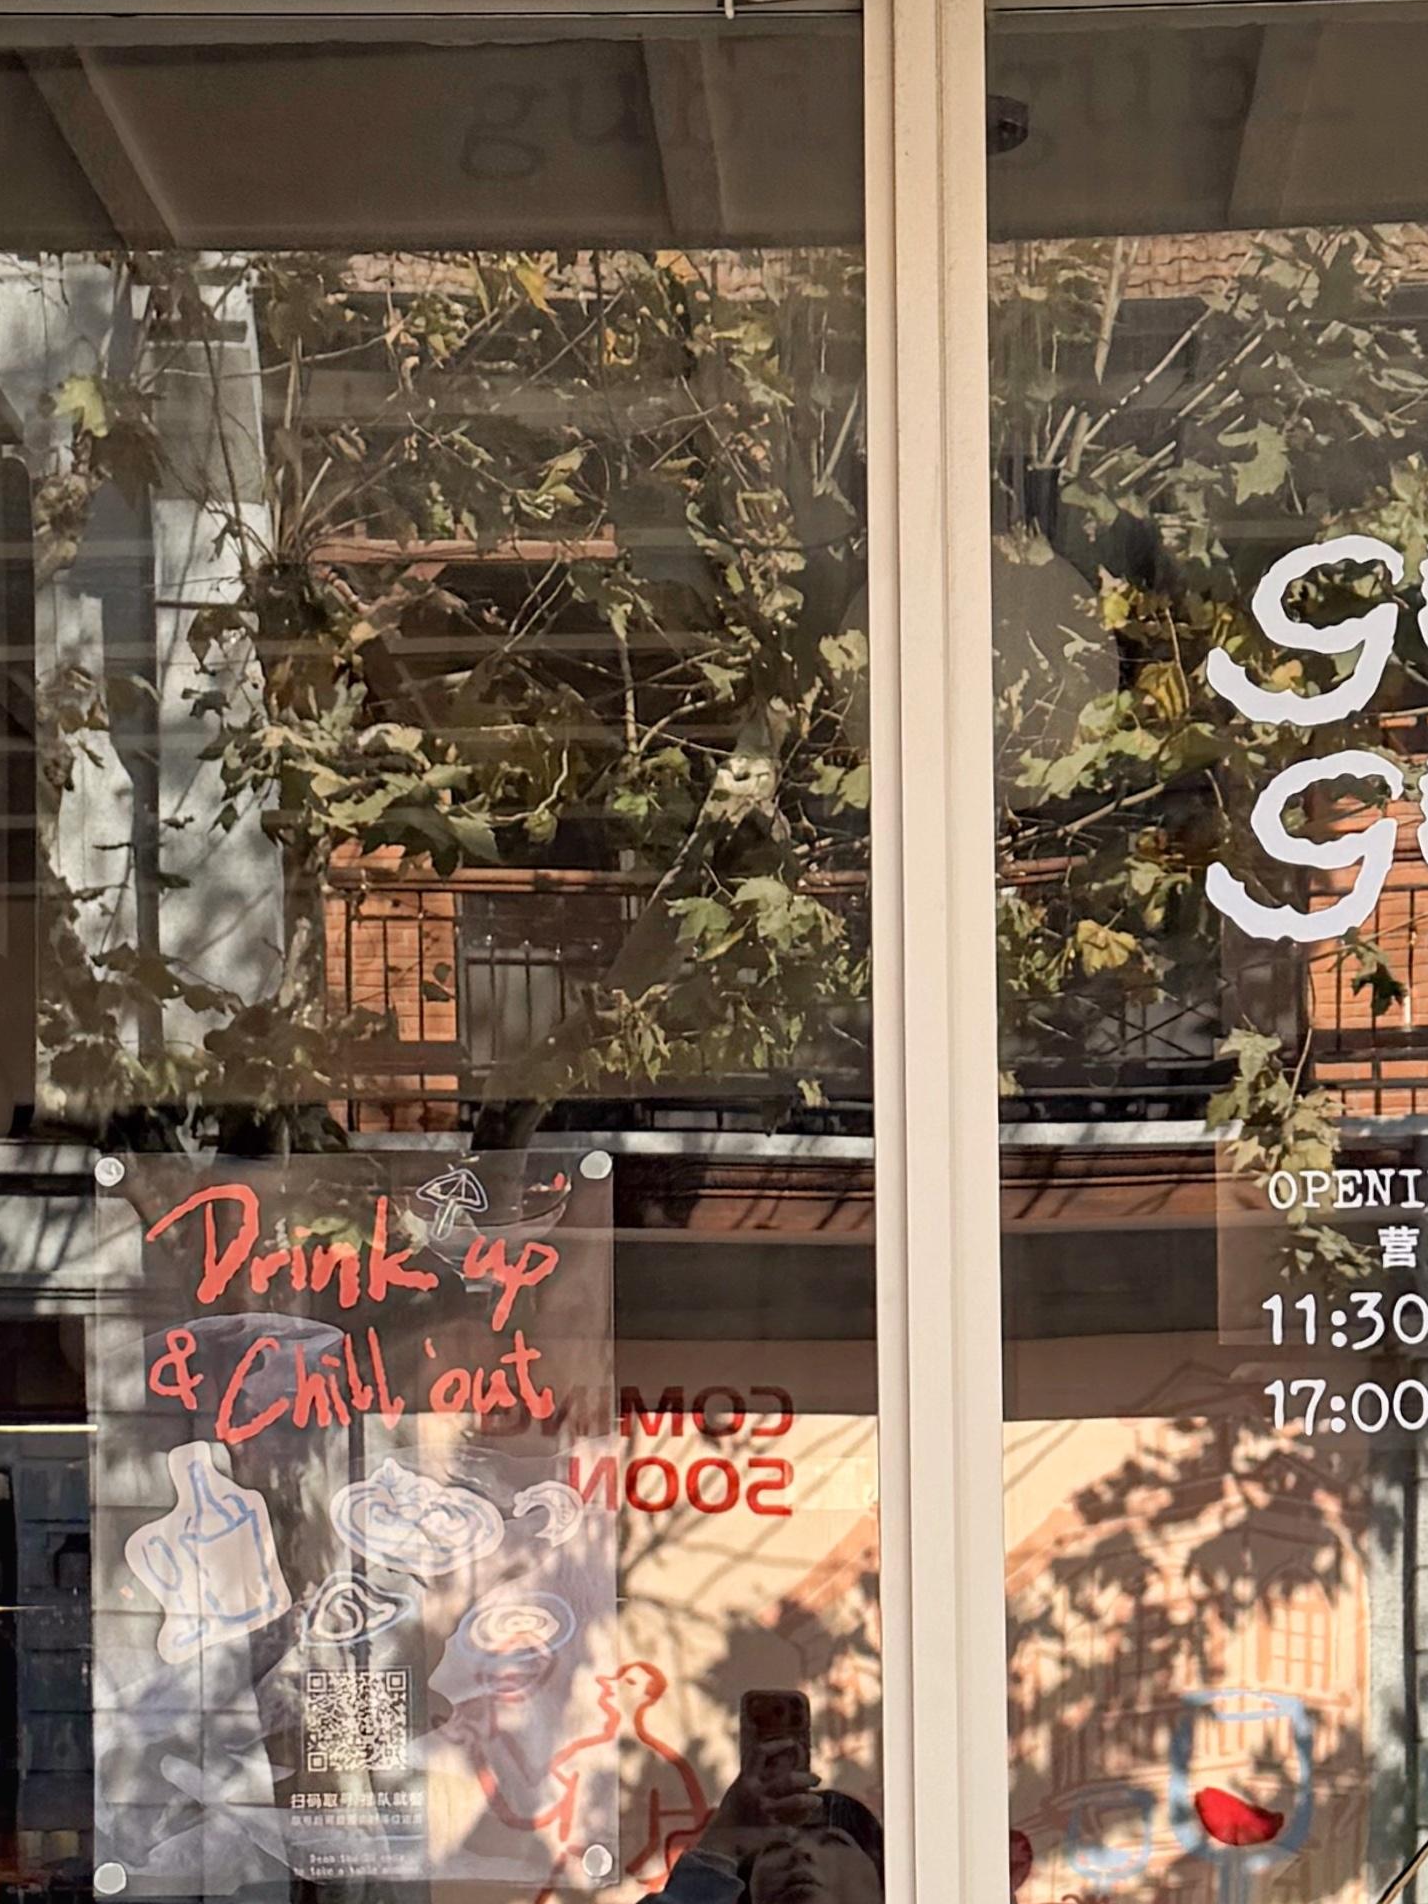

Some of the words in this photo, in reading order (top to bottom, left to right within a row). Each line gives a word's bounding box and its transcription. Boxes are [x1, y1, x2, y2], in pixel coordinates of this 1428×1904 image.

[146, 1184, 439, 1308] Drink
[463, 1235, 559, 1332] up
[149, 1328, 204, 1409] &
[215, 1327, 405, 1445] Chill
